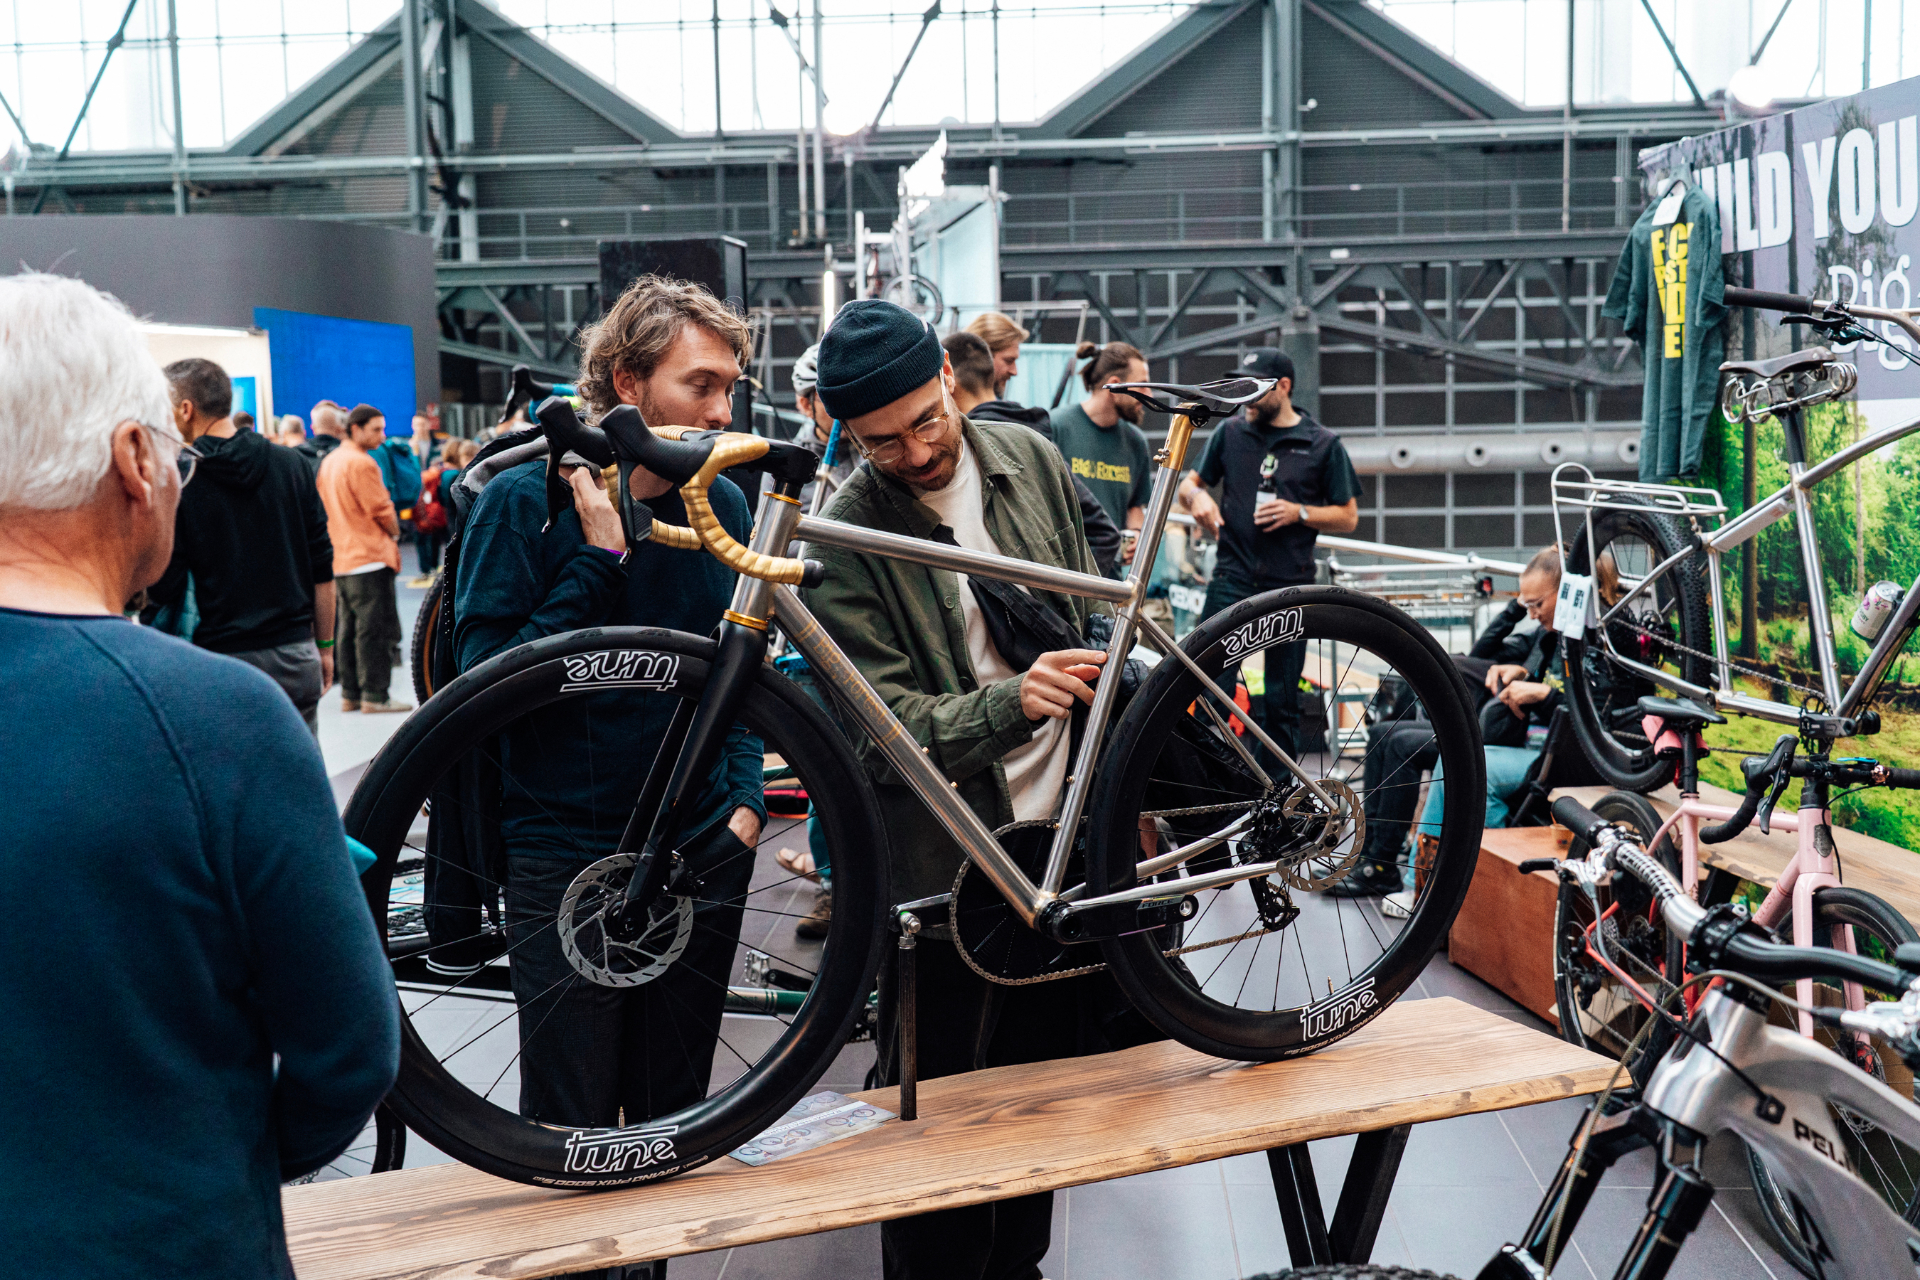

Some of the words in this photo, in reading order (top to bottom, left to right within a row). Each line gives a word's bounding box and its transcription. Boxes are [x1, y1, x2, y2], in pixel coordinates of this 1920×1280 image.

[1802, 115, 1919, 239] YOU
[1221, 607, 1304, 668] tune
[560, 650, 680, 692] tune
[1300, 976, 1379, 1041] tune
[564, 1125, 679, 1174] tune
[554, 1179, 597, 1187] 5000
[598, 1177, 632, 1187] PRIX
[632, 1166, 680, 1183] GRAND
